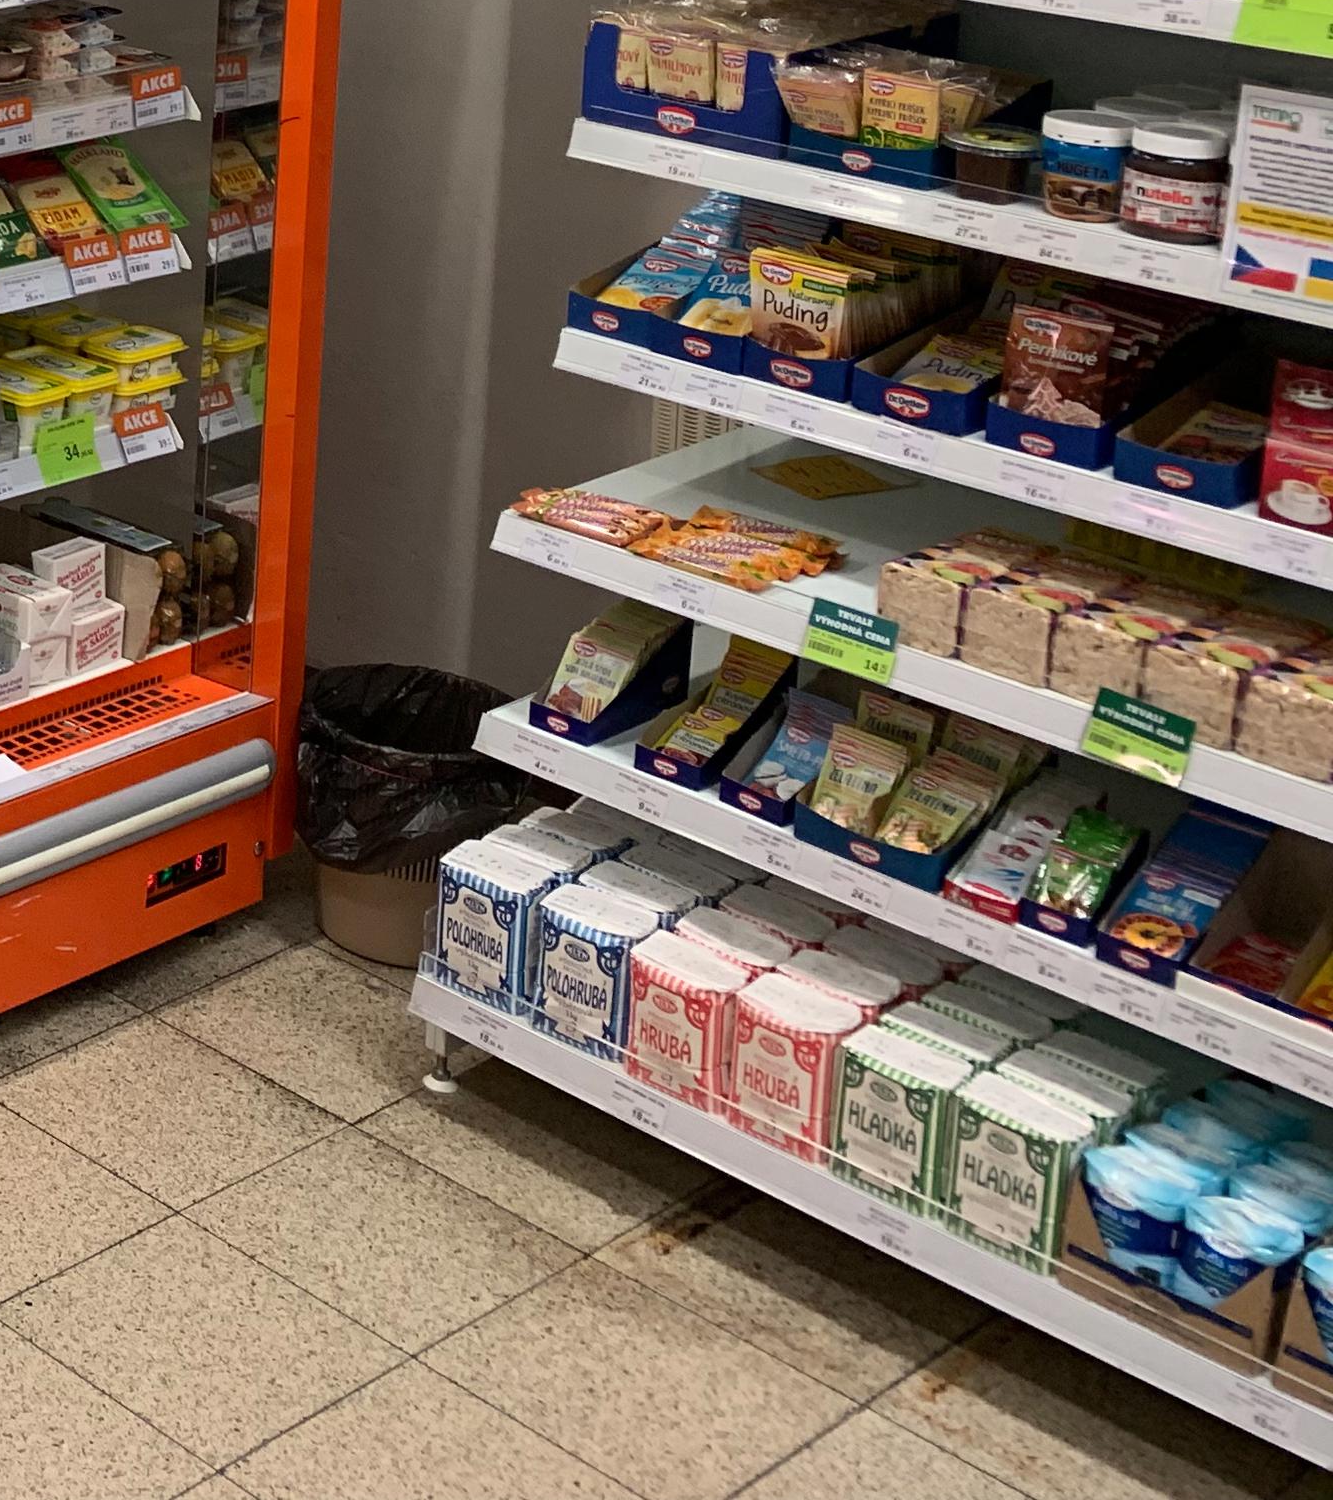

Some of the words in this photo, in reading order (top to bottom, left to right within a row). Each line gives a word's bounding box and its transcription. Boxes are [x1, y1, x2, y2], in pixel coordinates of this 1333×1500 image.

[140, 71, 175, 95] AKCE
[1057, 161, 1110, 181] NUGETA
[1136, 186, 1194, 205] nutella
[41, 206, 82, 225] EIDAM
[73, 240, 111, 262] AKCE
[128, 229, 165, 250] AKCE
[763, 289, 829, 332] Puding
[123, 408, 160, 431] AKCE
[837, 608, 875, 628] TRVALE
[815, 614, 863, 639] VÝHODNÁ
[864, 629, 891, 647] CENA
[446, 917, 504, 963] POLOHRUBÁ
[546, 964, 608, 1012] POLOHRUBÁ
[640, 1018, 692, 1064] HRUBÁ
[743, 1062, 800, 1110] HRUBÁ
[849, 1100, 917, 1155] HLADKÁ
